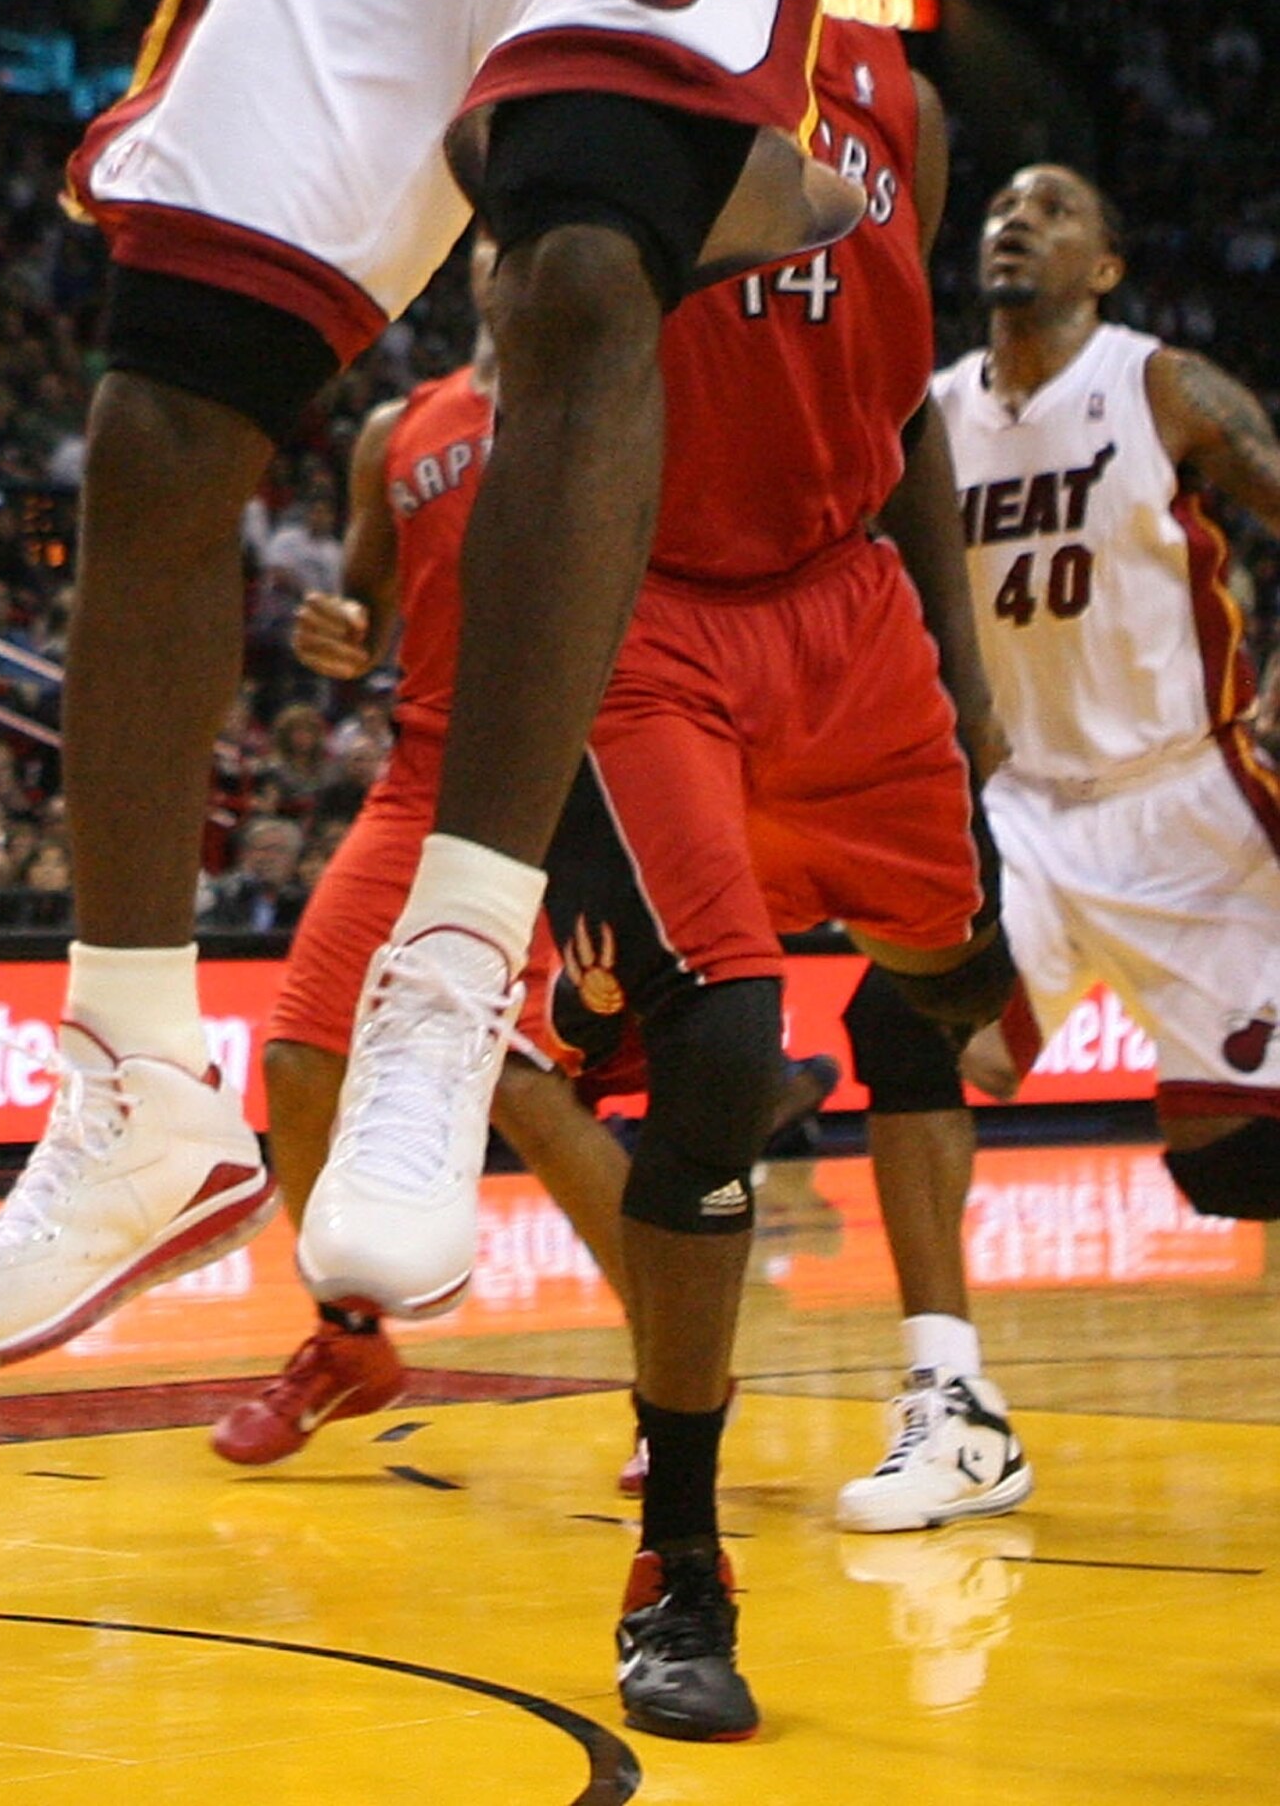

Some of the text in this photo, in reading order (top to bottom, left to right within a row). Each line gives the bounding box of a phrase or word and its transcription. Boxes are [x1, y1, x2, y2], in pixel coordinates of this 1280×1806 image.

[820, 119, 897, 224] RS
[742, 247, 840, 322] 14
[994, 544, 1094, 628] 40
